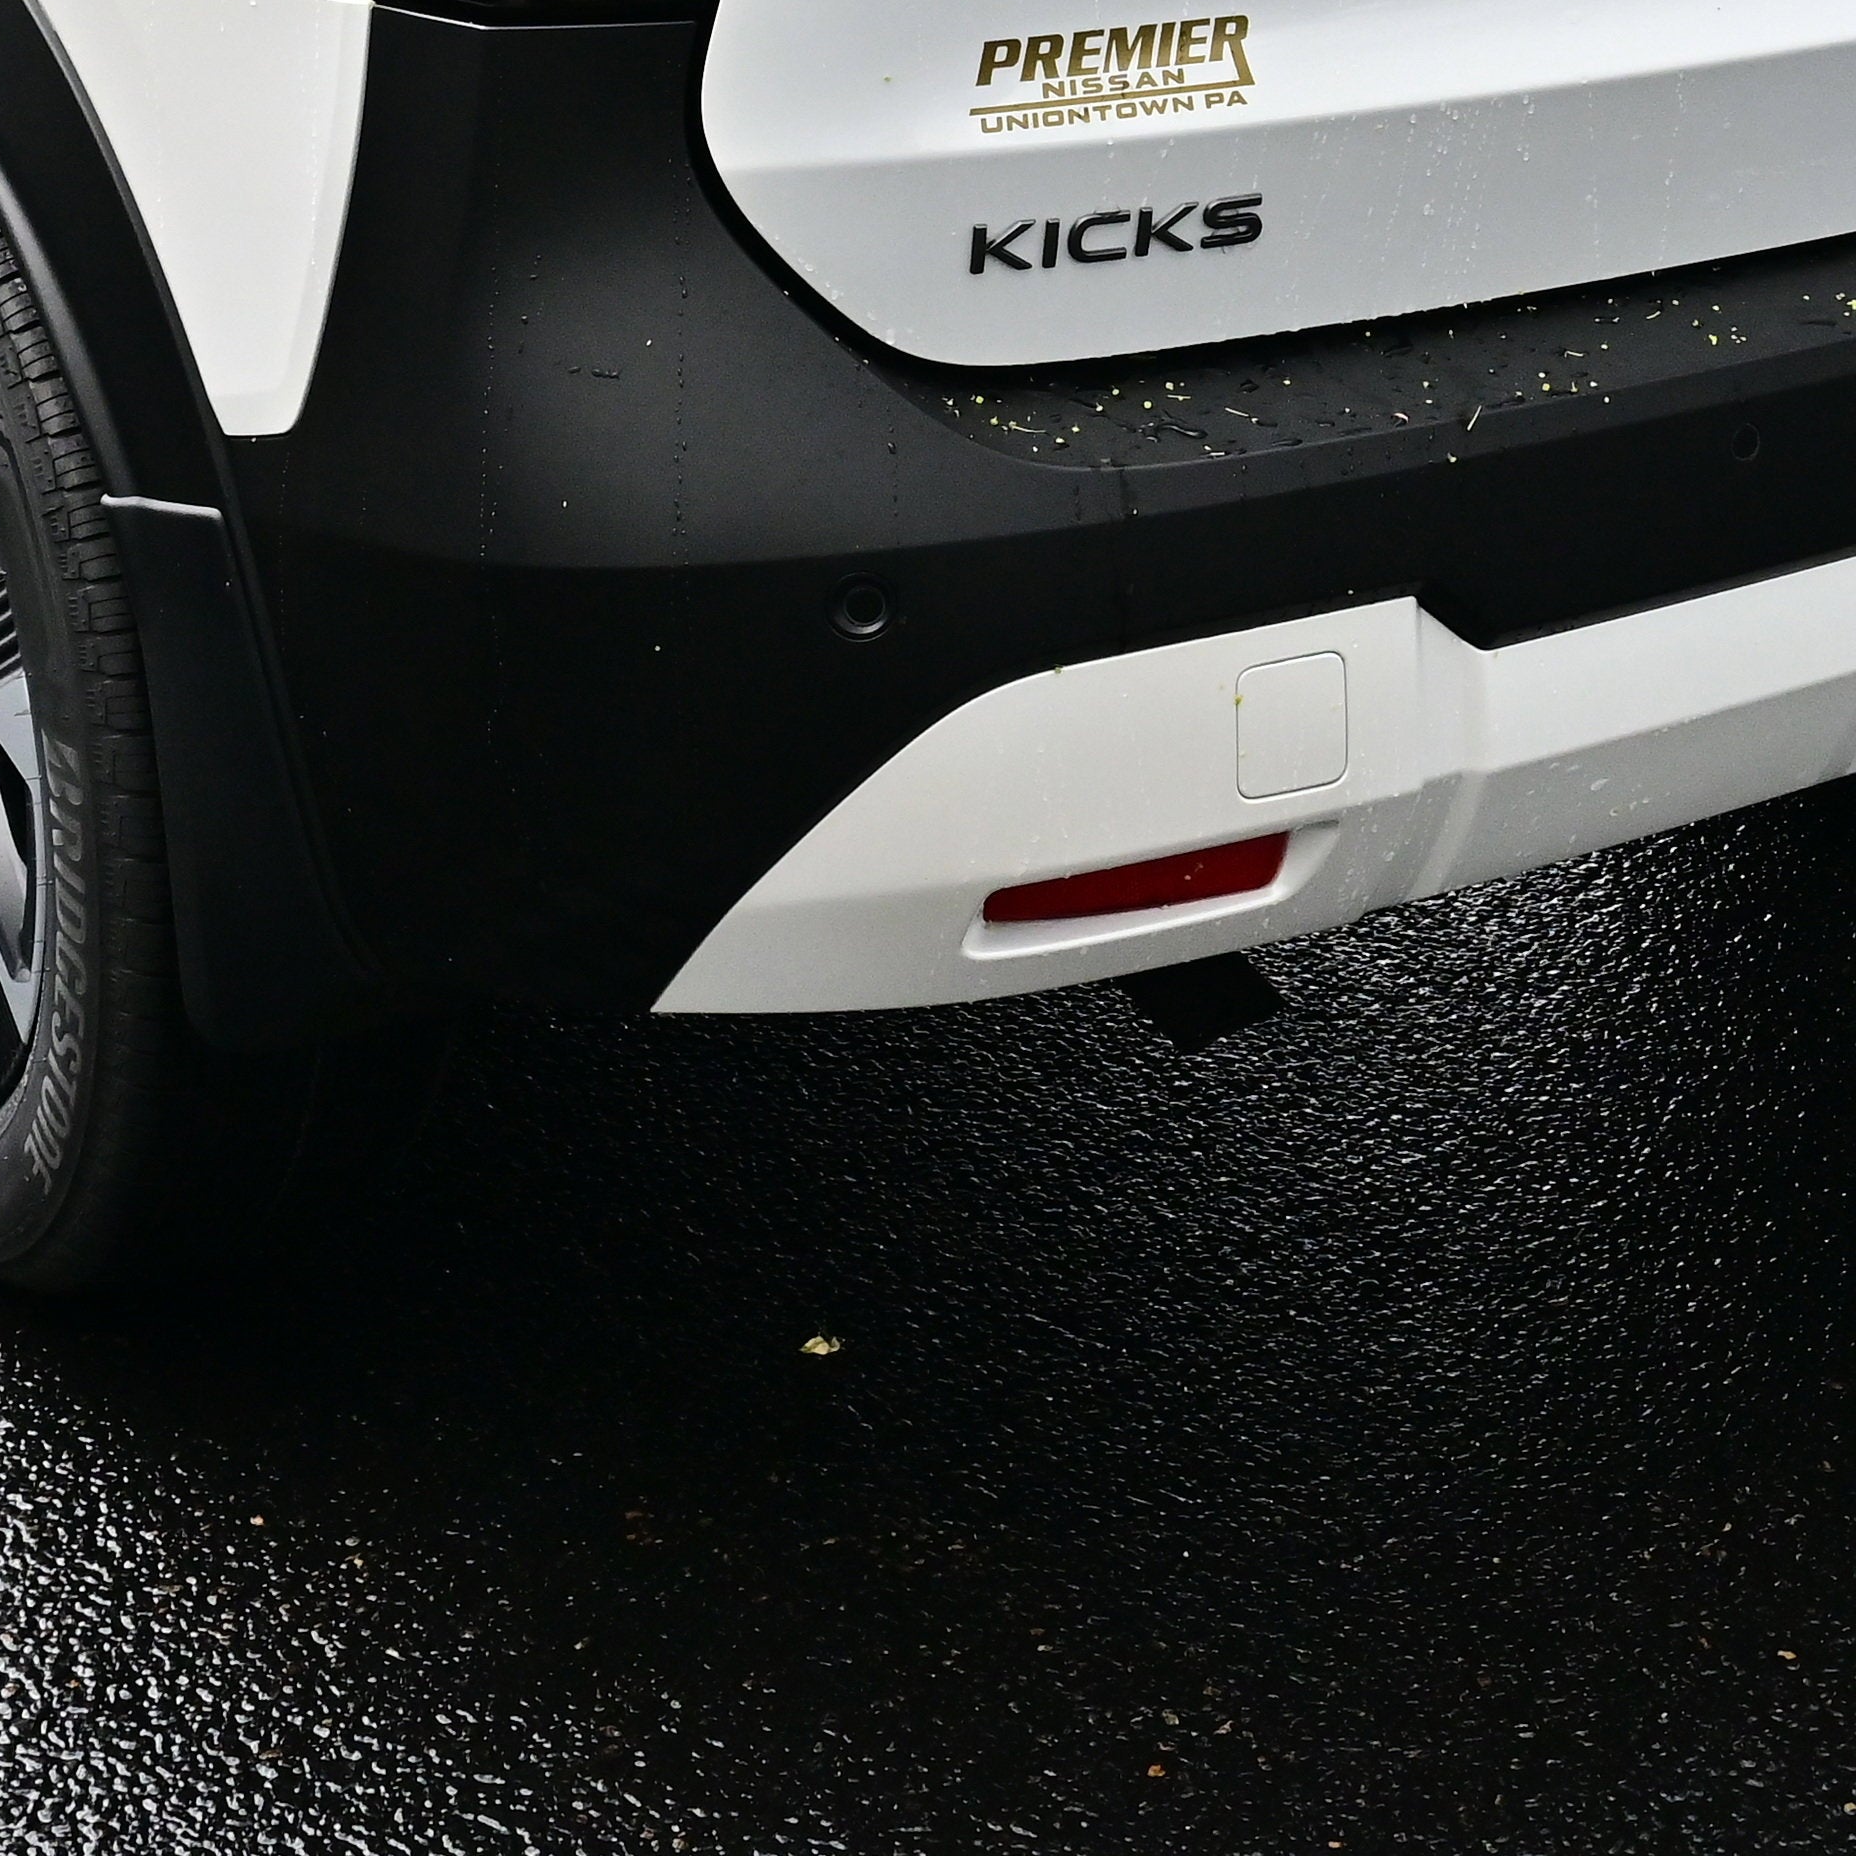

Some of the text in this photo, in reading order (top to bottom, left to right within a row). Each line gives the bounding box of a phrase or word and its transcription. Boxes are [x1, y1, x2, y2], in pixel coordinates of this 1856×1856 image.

[975, 14, 1255, 87] PREMIER
[1042, 68, 1185, 99] NISSAN
[980, 89, 1248, 134] UNIONTOWN PA
[969, 192, 1263, 275] KICKS
[23, 727, 87, 1196] BRIDGESTONE
